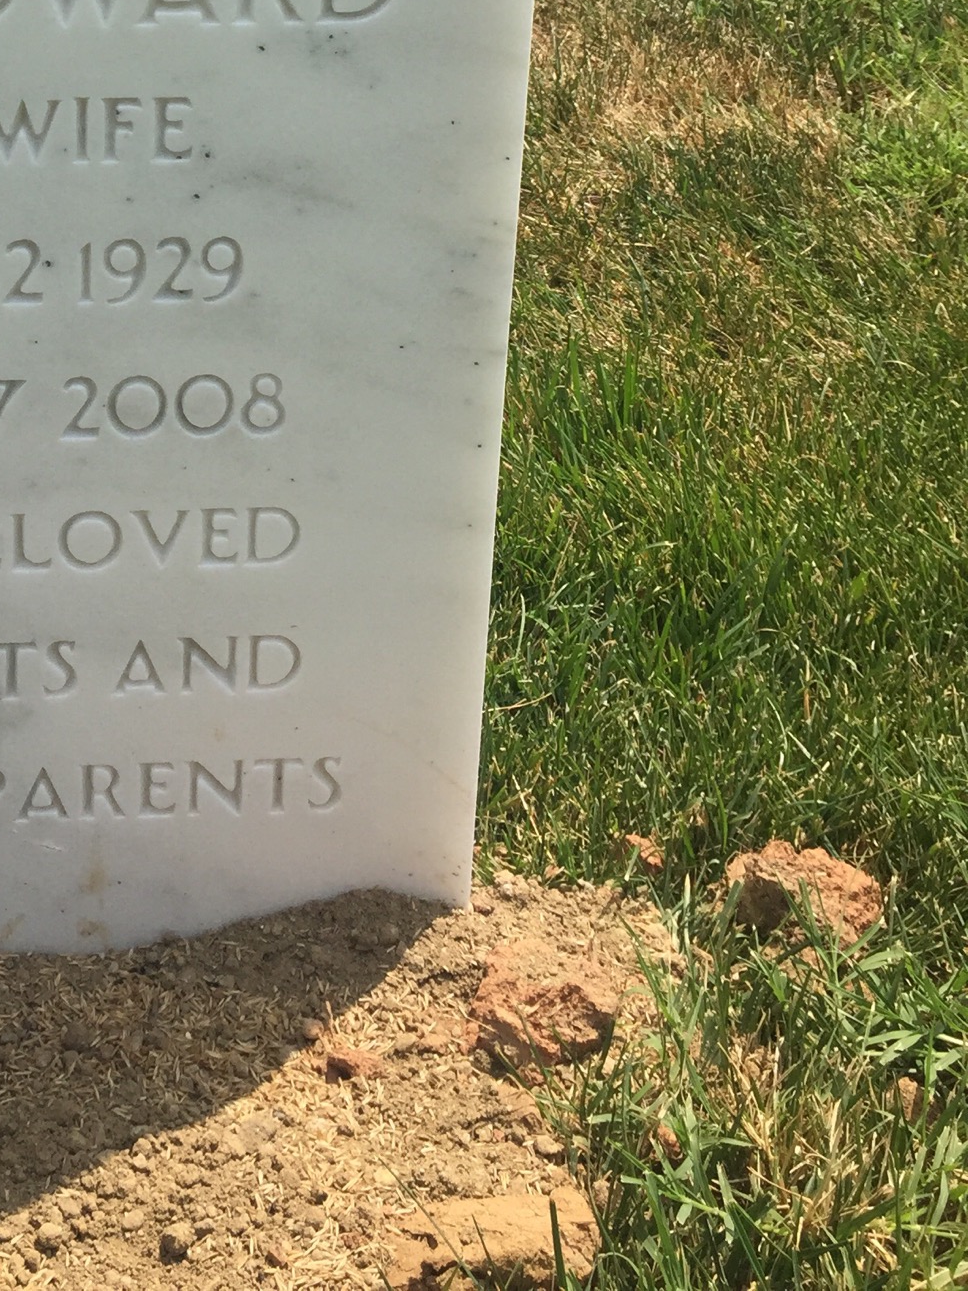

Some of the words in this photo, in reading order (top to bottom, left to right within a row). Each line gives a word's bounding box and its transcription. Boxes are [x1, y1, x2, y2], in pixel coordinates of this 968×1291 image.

[2, 238, 44, 306] 2
[78, 235, 244, 306] 1929
[59, 373, 287, 441] 2008
[110, 634, 303, 697] AND
